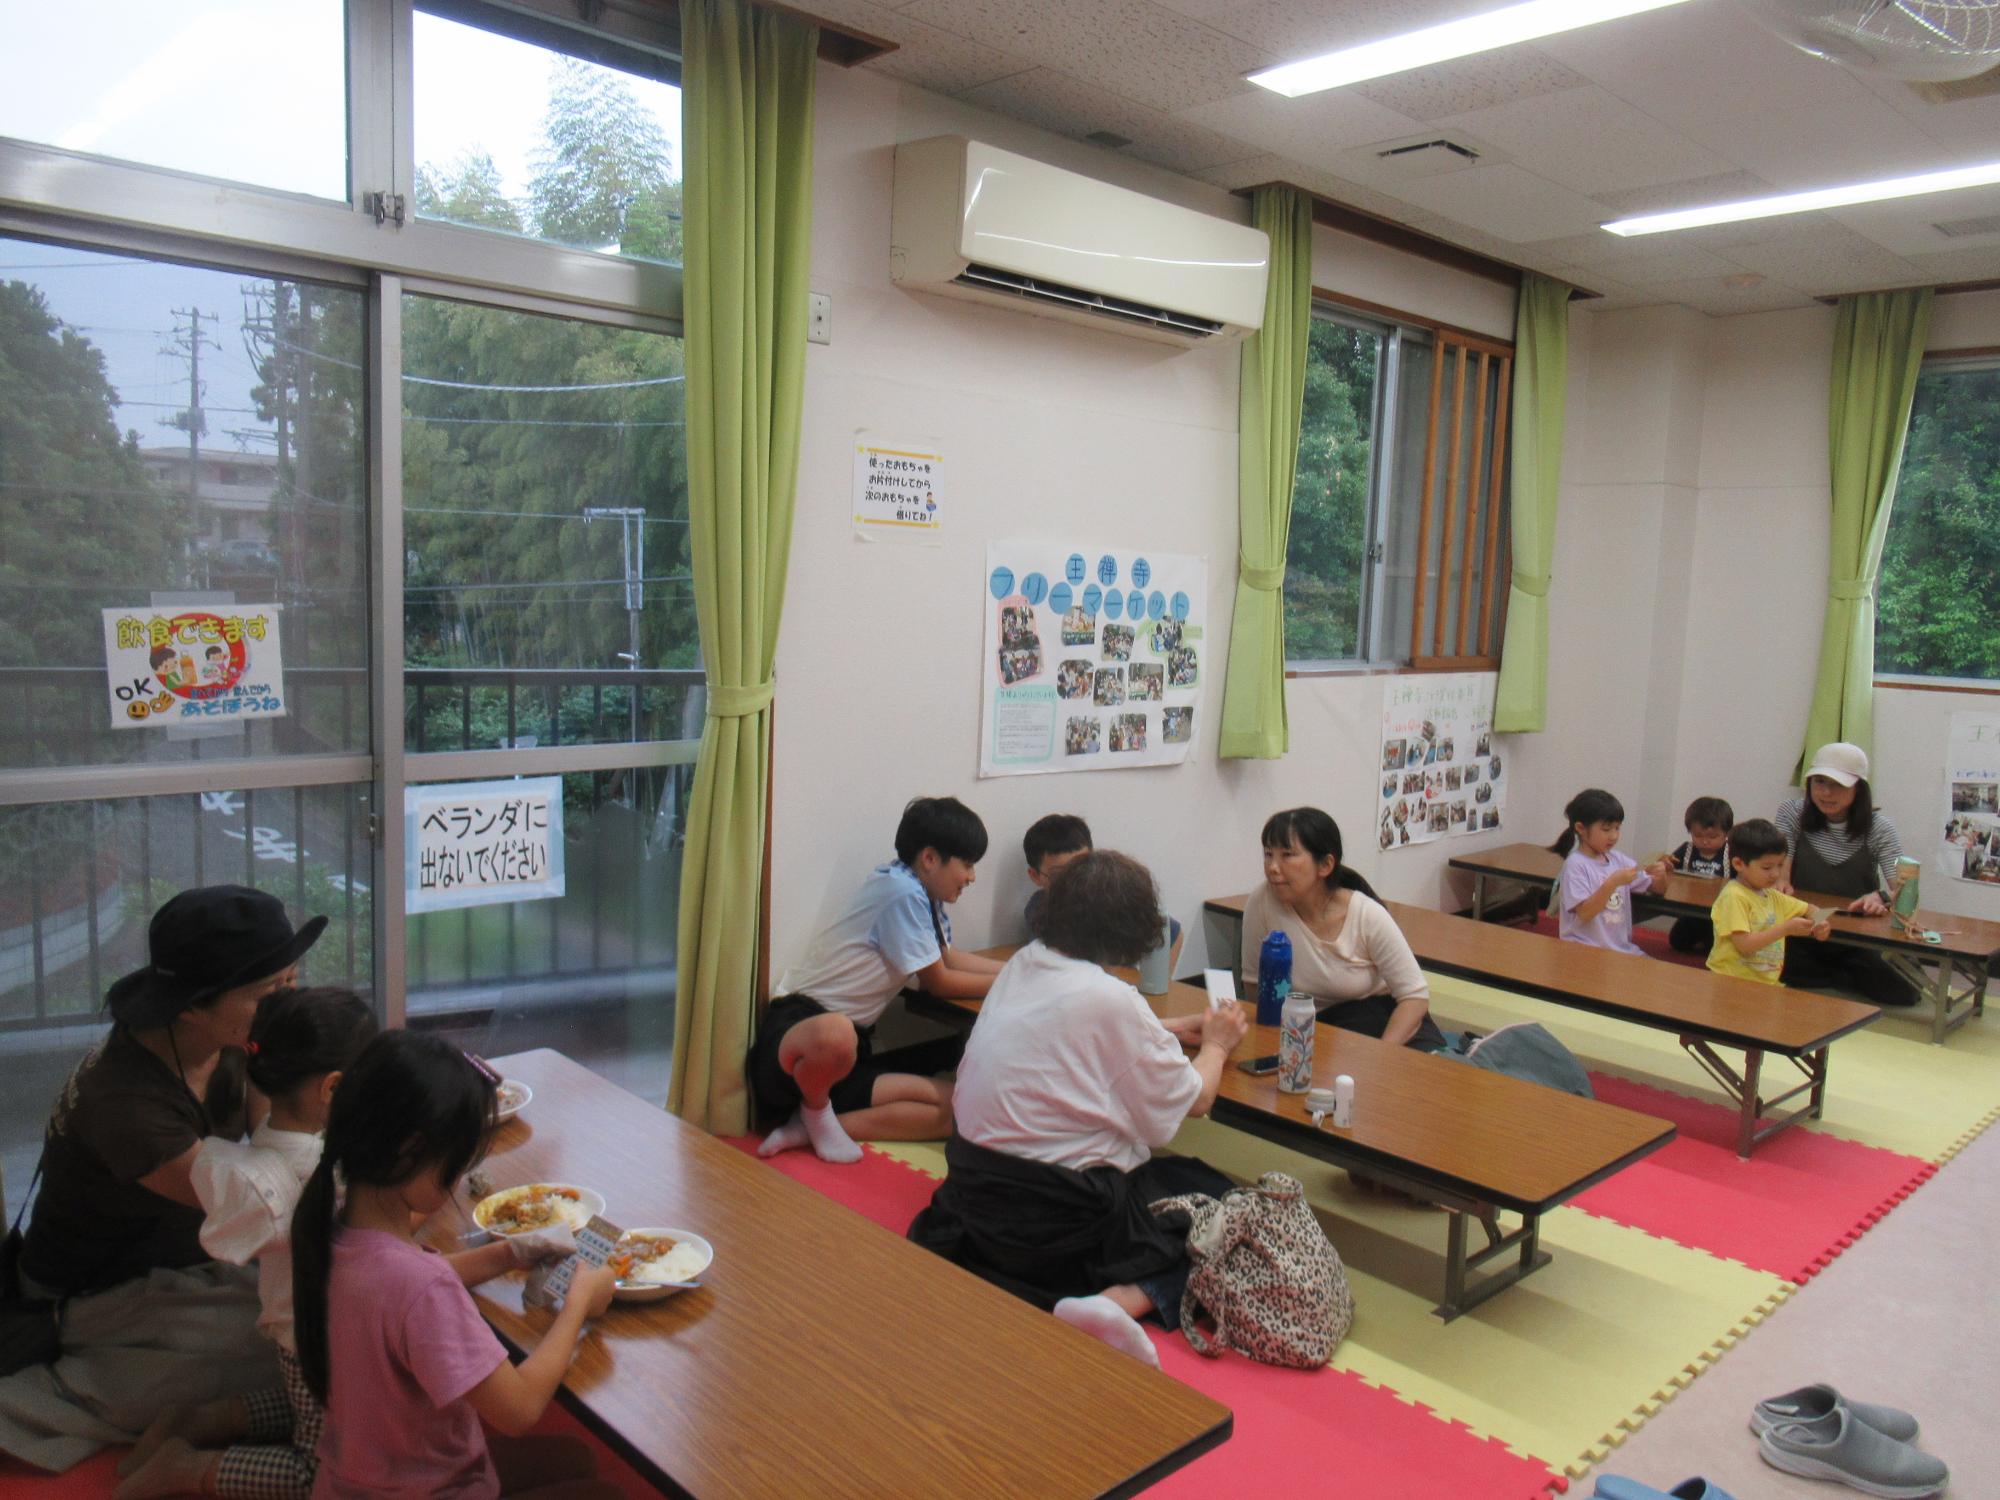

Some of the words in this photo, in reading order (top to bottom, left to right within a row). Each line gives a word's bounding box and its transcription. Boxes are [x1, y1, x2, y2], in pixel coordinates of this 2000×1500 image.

[869, 456, 931, 473] 使ったおもちゃを
[868, 474, 931, 489] お片付けしてから
[865, 490, 919, 504] 次のおもちゃを
[991, 573, 1186, 617] フリーマーケット
[116, 613, 269, 649] 飲食できます
[115, 677, 153, 701] OK
[181, 695, 281, 717] あそぼうね
[423, 799, 547, 839] ベランダに
[420, 838, 546, 889] 出ないでください
